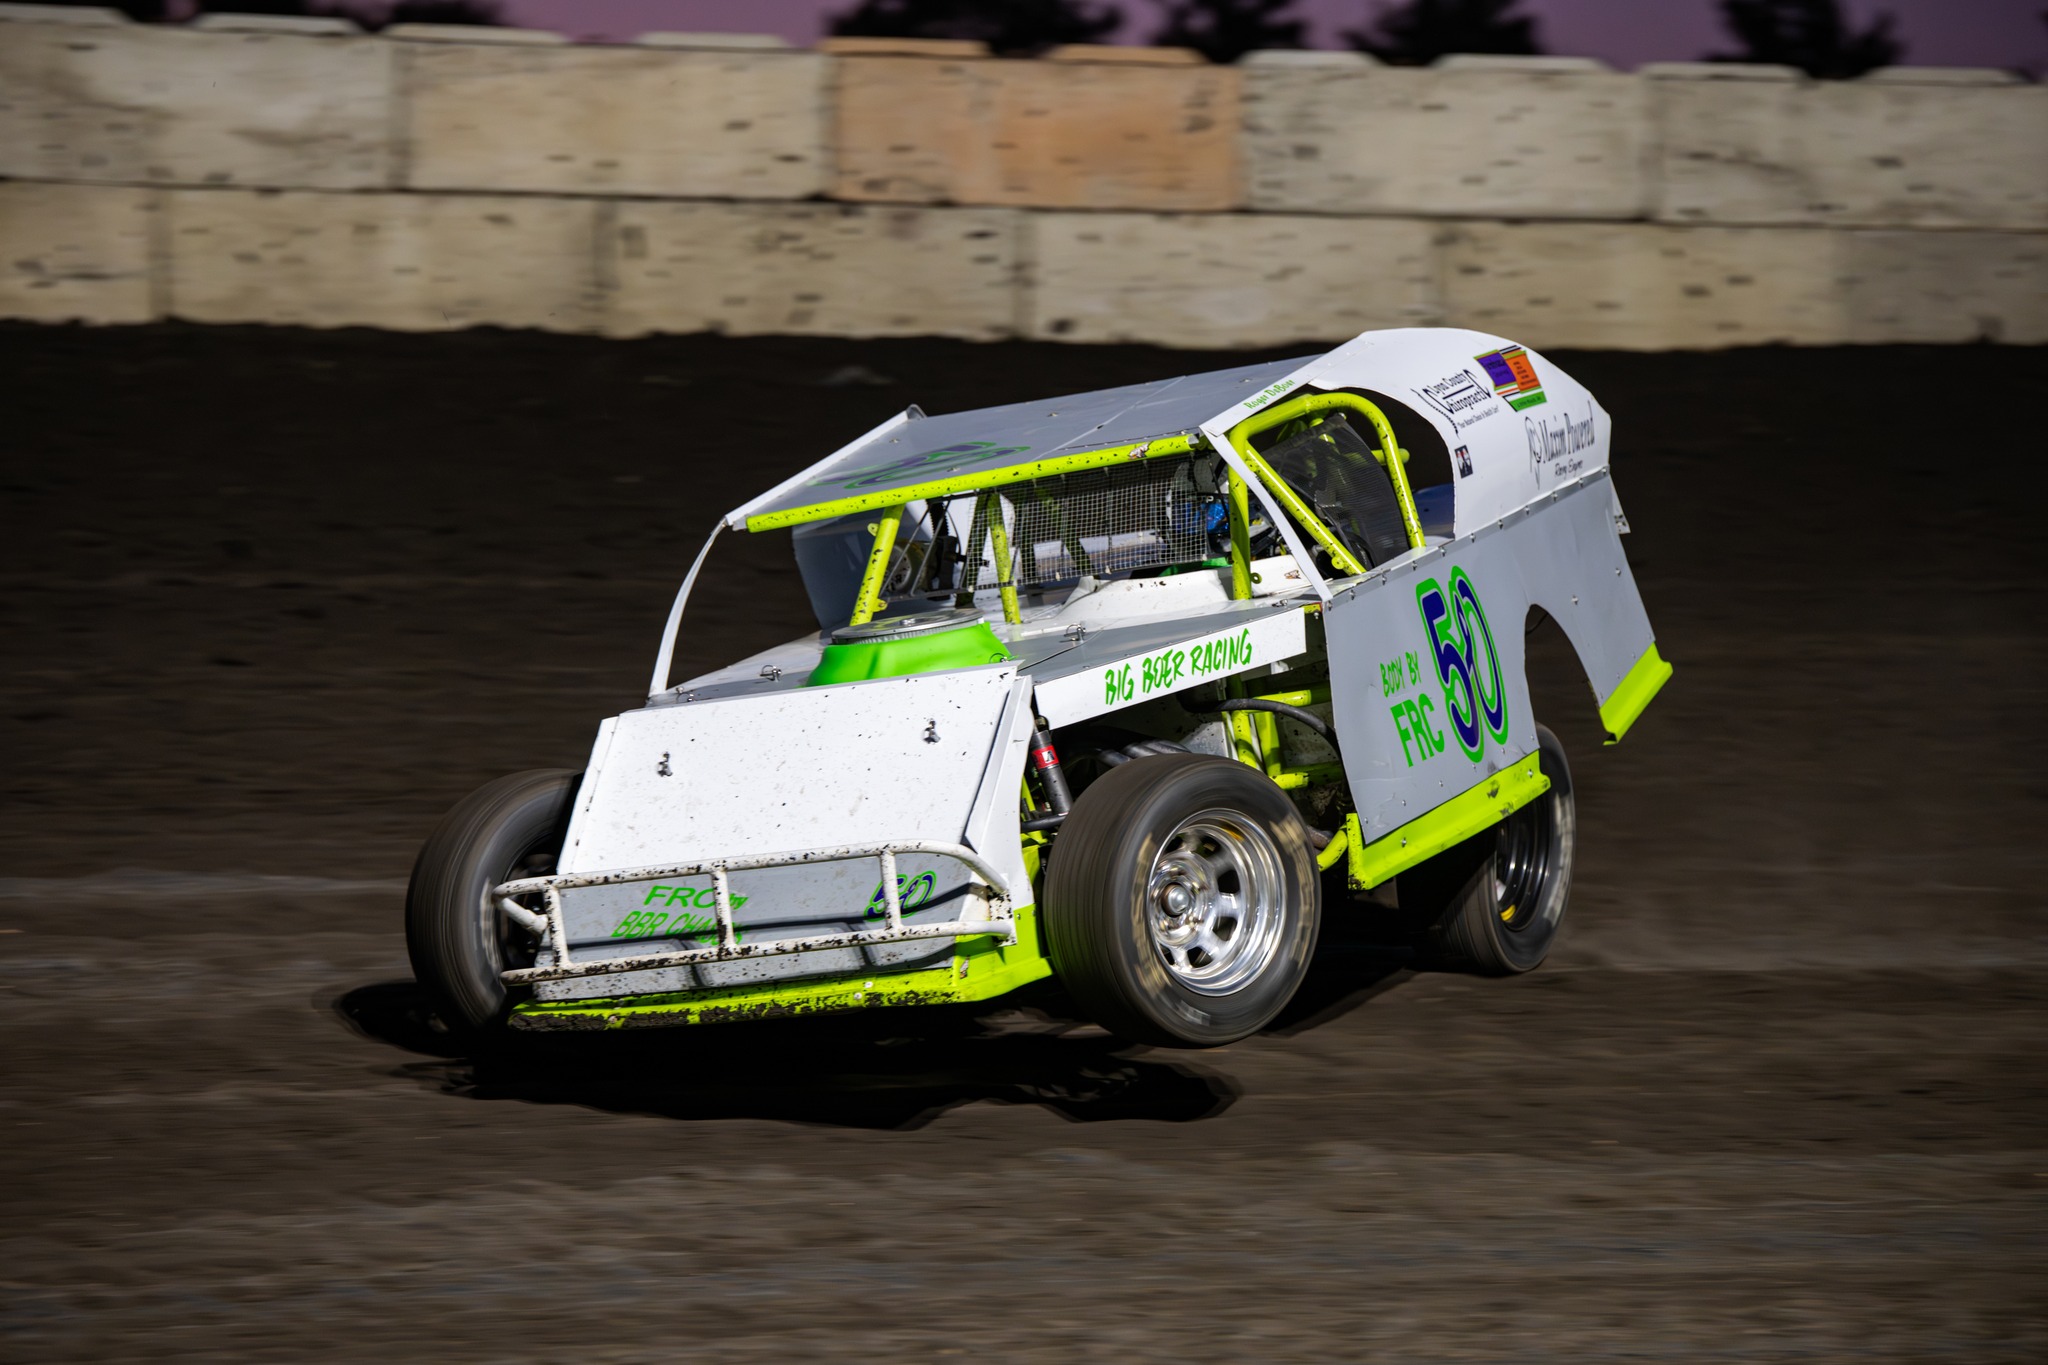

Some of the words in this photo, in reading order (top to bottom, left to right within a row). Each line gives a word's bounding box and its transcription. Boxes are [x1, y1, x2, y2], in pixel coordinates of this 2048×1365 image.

[1442, 371, 1472, 388] County
[1564, 400, 1595, 455] Powered
[1105, 662, 1134, 706] BIG
[1142, 648, 1185, 694] BOER
[1190, 627, 1253, 677] RACING
[1380, 655, 1406, 698] BODY
[1405, 650, 1422, 686] BY
[1415, 565, 1509, 764] 50
[1390, 693, 1445, 768] FRC
[643, 885, 716, 909] FRC
[863, 870, 937, 923] 50
[610, 910, 669, 939] BBR
